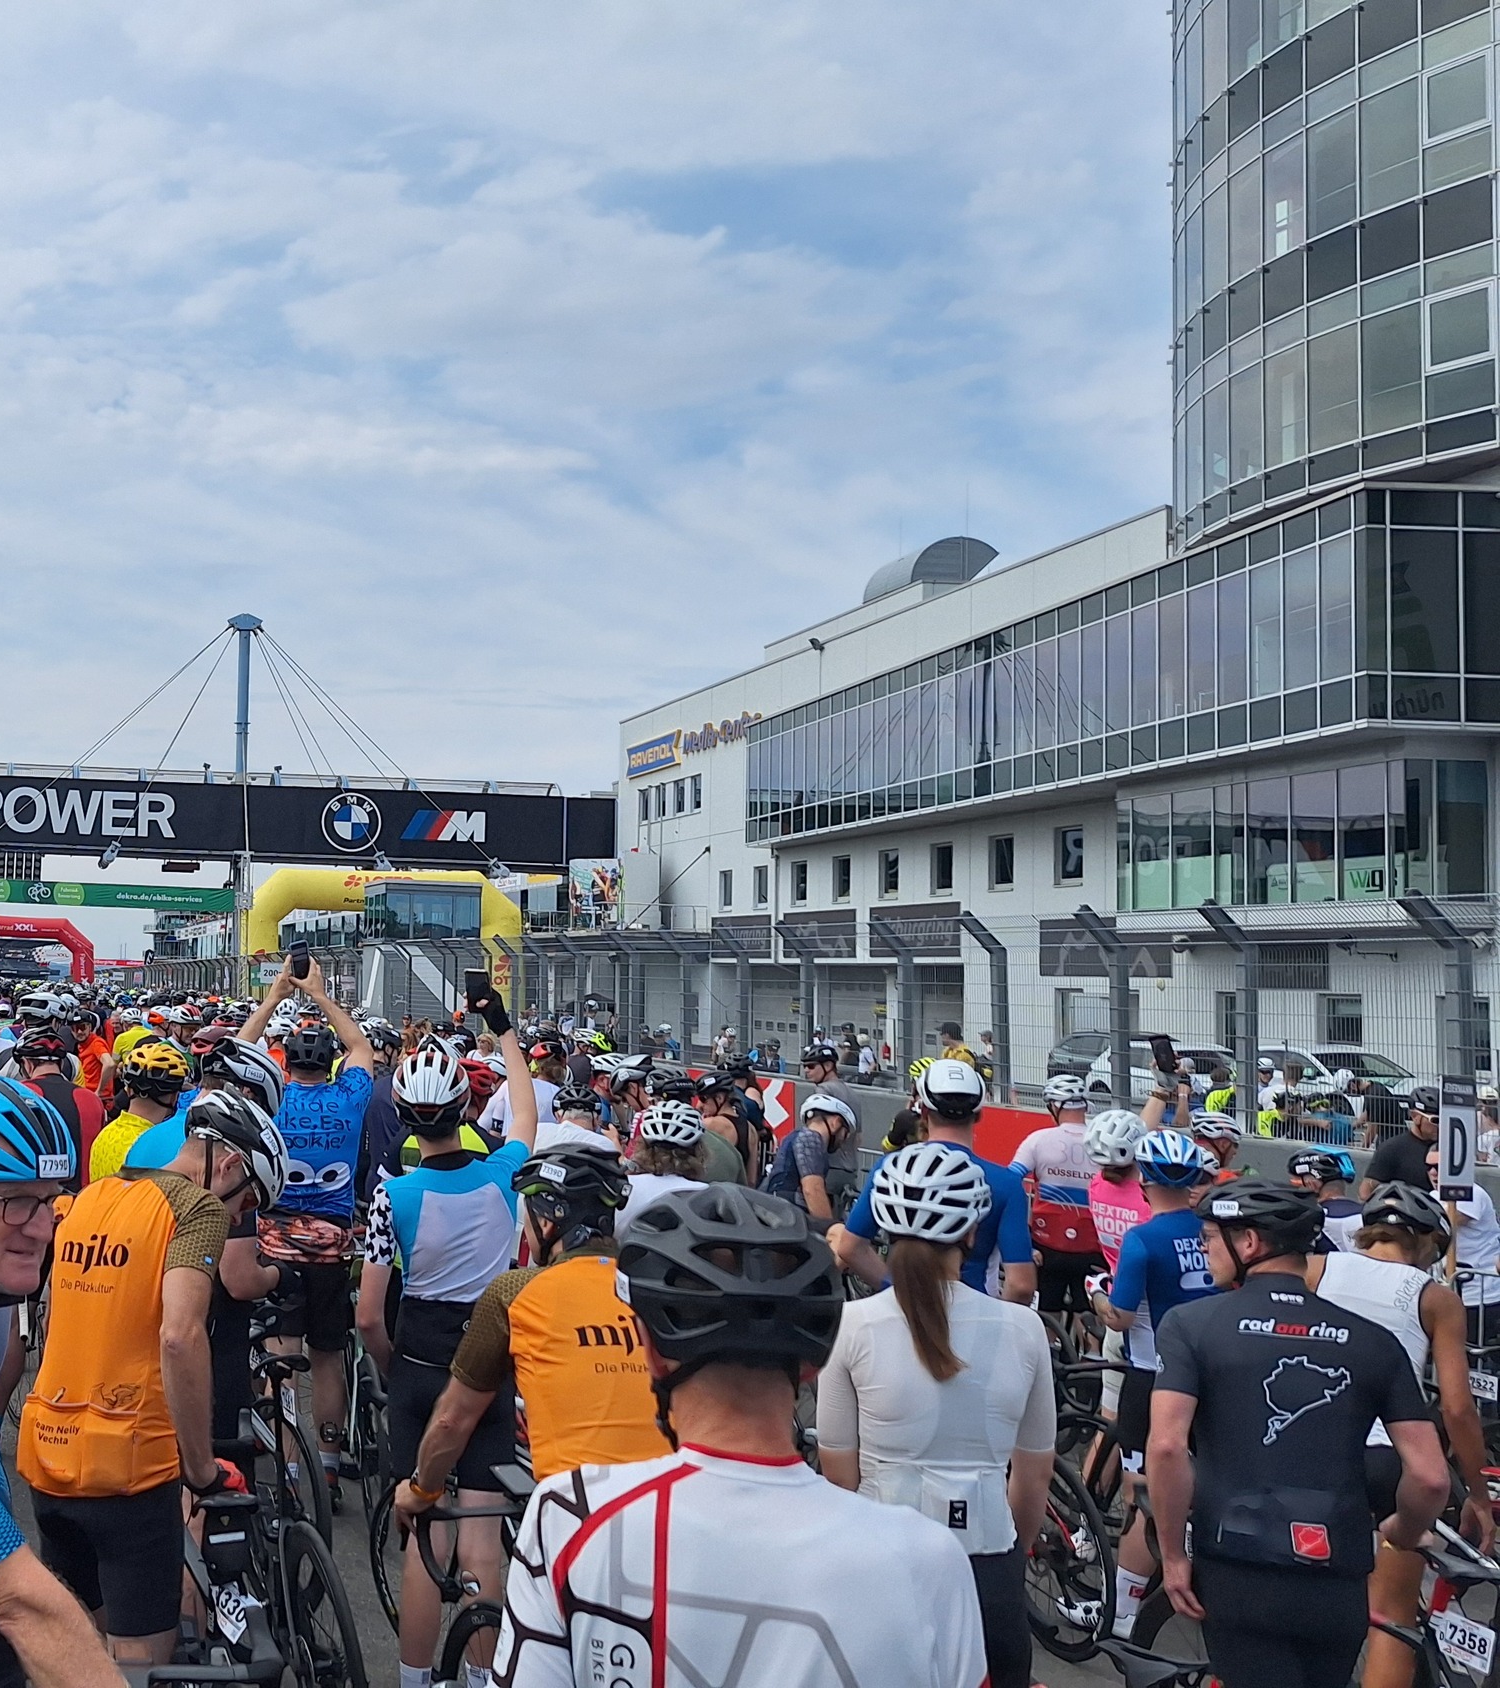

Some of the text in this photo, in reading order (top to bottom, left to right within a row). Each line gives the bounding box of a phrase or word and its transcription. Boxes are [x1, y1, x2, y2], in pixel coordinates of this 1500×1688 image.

[630, 743, 674, 769] RAVENOL
[330, 795, 374, 813] BMW
[116, 892, 204, 903] dekra.de/ebike-services
[14, 922, 38, 932] XXL
[263, 969, 283, 977] 200
[284, 1097, 340, 1117] Ride
[1448, 1116, 1468, 1177] D
[1047, 1165, 1097, 1181] DÜSSELDO
[1092, 1201, 1139, 1222] DEXTRO
[1172, 1236, 1201, 1254] DEX
[60, 1278, 73, 1290] Die
[594, 1361, 617, 1374] Die
[37, 1432, 69, 1446] Vechta
[56, 1425, 81, 1437] Nelly
[1447, 1623, 1489, 1656] 7358
[591, 1637, 607, 1687] BIKE
